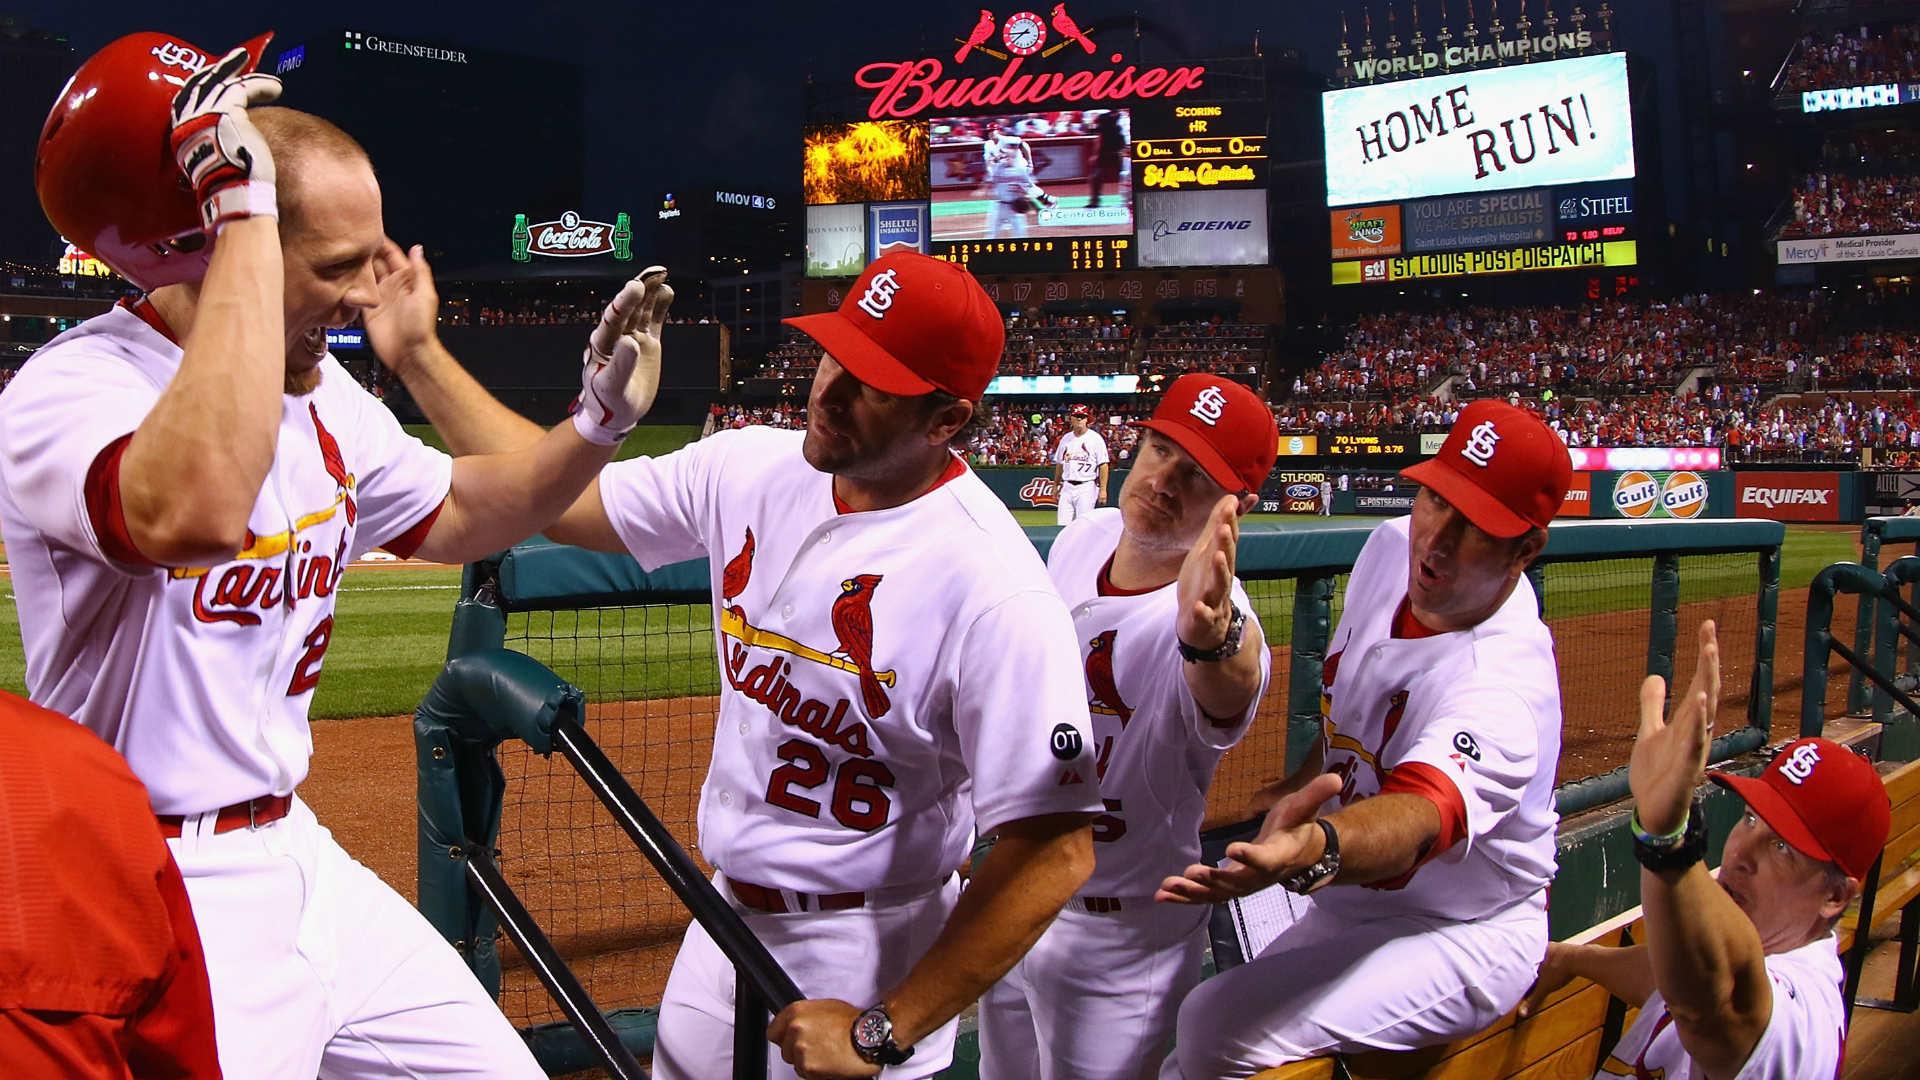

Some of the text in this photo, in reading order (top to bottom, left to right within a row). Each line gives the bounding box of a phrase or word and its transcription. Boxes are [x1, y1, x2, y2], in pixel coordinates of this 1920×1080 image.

[366, 36, 468, 64] GREENSFELDER
[1353, 30, 1593, 80] WORLD CHAMPIONS
[275, 53, 302, 76] KPMG
[854, 52, 1206, 120] Budweiser
[1175, 106, 1222, 117] SCORING
[1189, 119, 1208, 132] HR
[1355, 85, 1476, 165] HOME
[1467, 93, 1597, 181] RUN!
[716, 190, 751, 206] KMOV
[1414, 191, 1544, 219] YOU ARE SPECIAL
[1580, 196, 1633, 217] STIFEL
[879, 219, 918, 228] SHELTER
[1099, 209, 1128, 218] Bank
[1461, 210, 1544, 230] SPECIALISTS
[1176, 220, 1252, 231] BOEING
[1459, 232, 1498, 246] University
[1499, 229, 1534, 242] Hospital
[1785, 238, 1897, 260] Mercy Medical Provider
[1394, 257, 1416, 277] ST.
[1419, 253, 1467, 276] LOUIS
[1472, 243, 1605, 271] POST-DISPATCH
[1044, 282, 1067, 300] 20
[1335, 435, 1348, 444] 70
[1077, 463, 1092, 473] 77
[1280, 473, 1325, 483] STLFORD
[1291, 486, 1313, 497] Ford
[1616, 484, 1656, 505] Gulf
[1663, 484, 1705, 505] Gulf
[1742, 487, 1828, 508] EQUIFAX
[1289, 501, 1315, 511] .COM
[1366, 497, 1410, 507] POSTSEASON
[1053, 730, 1078, 751] OT
[764, 738, 896, 833] 26
